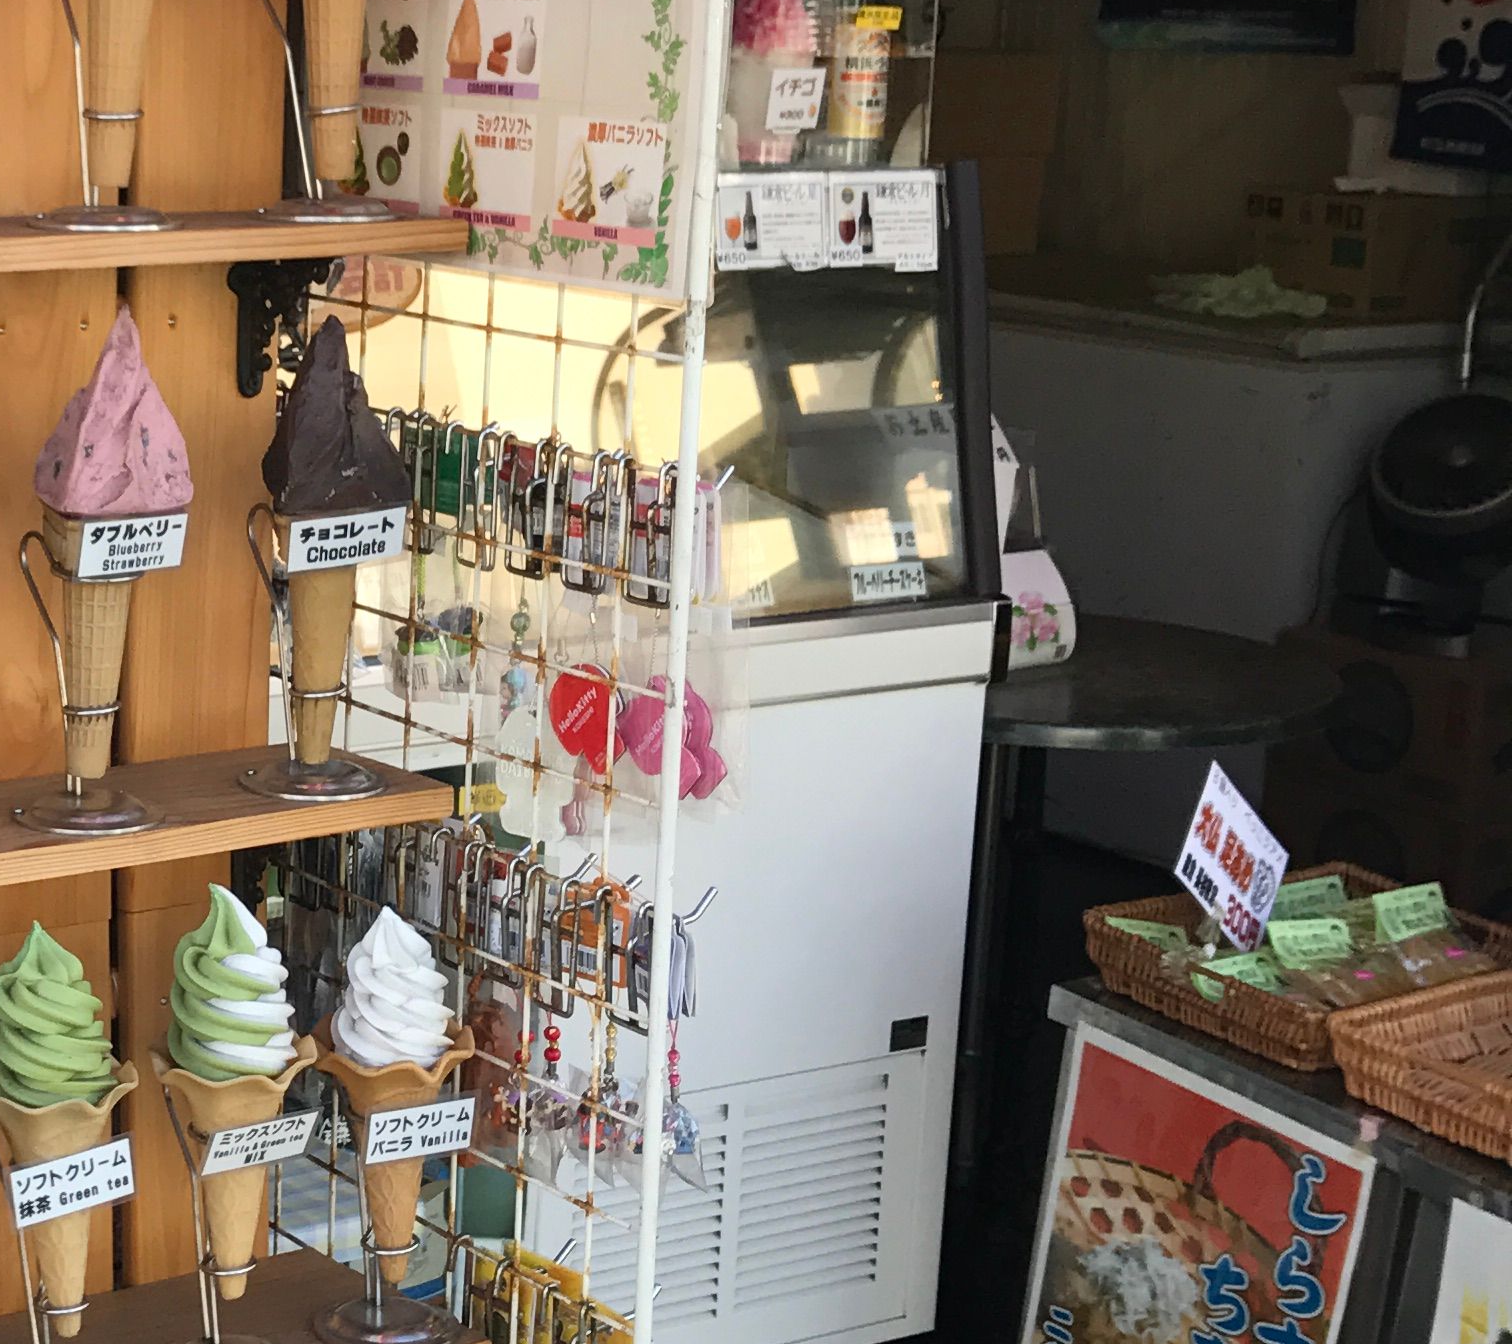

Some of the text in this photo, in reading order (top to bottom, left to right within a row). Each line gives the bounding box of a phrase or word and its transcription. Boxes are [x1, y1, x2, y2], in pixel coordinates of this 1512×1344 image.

[775, 77, 818, 99] イチゴ
[831, 249, 861, 262] ¥650
[88, 518, 184, 546] ダブルベリー
[296, 516, 397, 545] チョコレート
[100, 552, 166, 572] Strawberry
[106, 538, 164, 559] Blueberry
[304, 537, 388, 564] Chocolate
[219, 1117, 306, 1146] ミックスソフト
[373, 1107, 471, 1137] ソフトクリーム
[213, 1144, 249, 1160] Vanilla
[260, 1136, 286, 1149] Green
[369, 1128, 470, 1157] バニラ Vanilla
[243, 1149, 268, 1165] MIX
[15, 1149, 128, 1196] ソフトクリーム
[17, 1173, 130, 1220] 抹茶 Green tea
